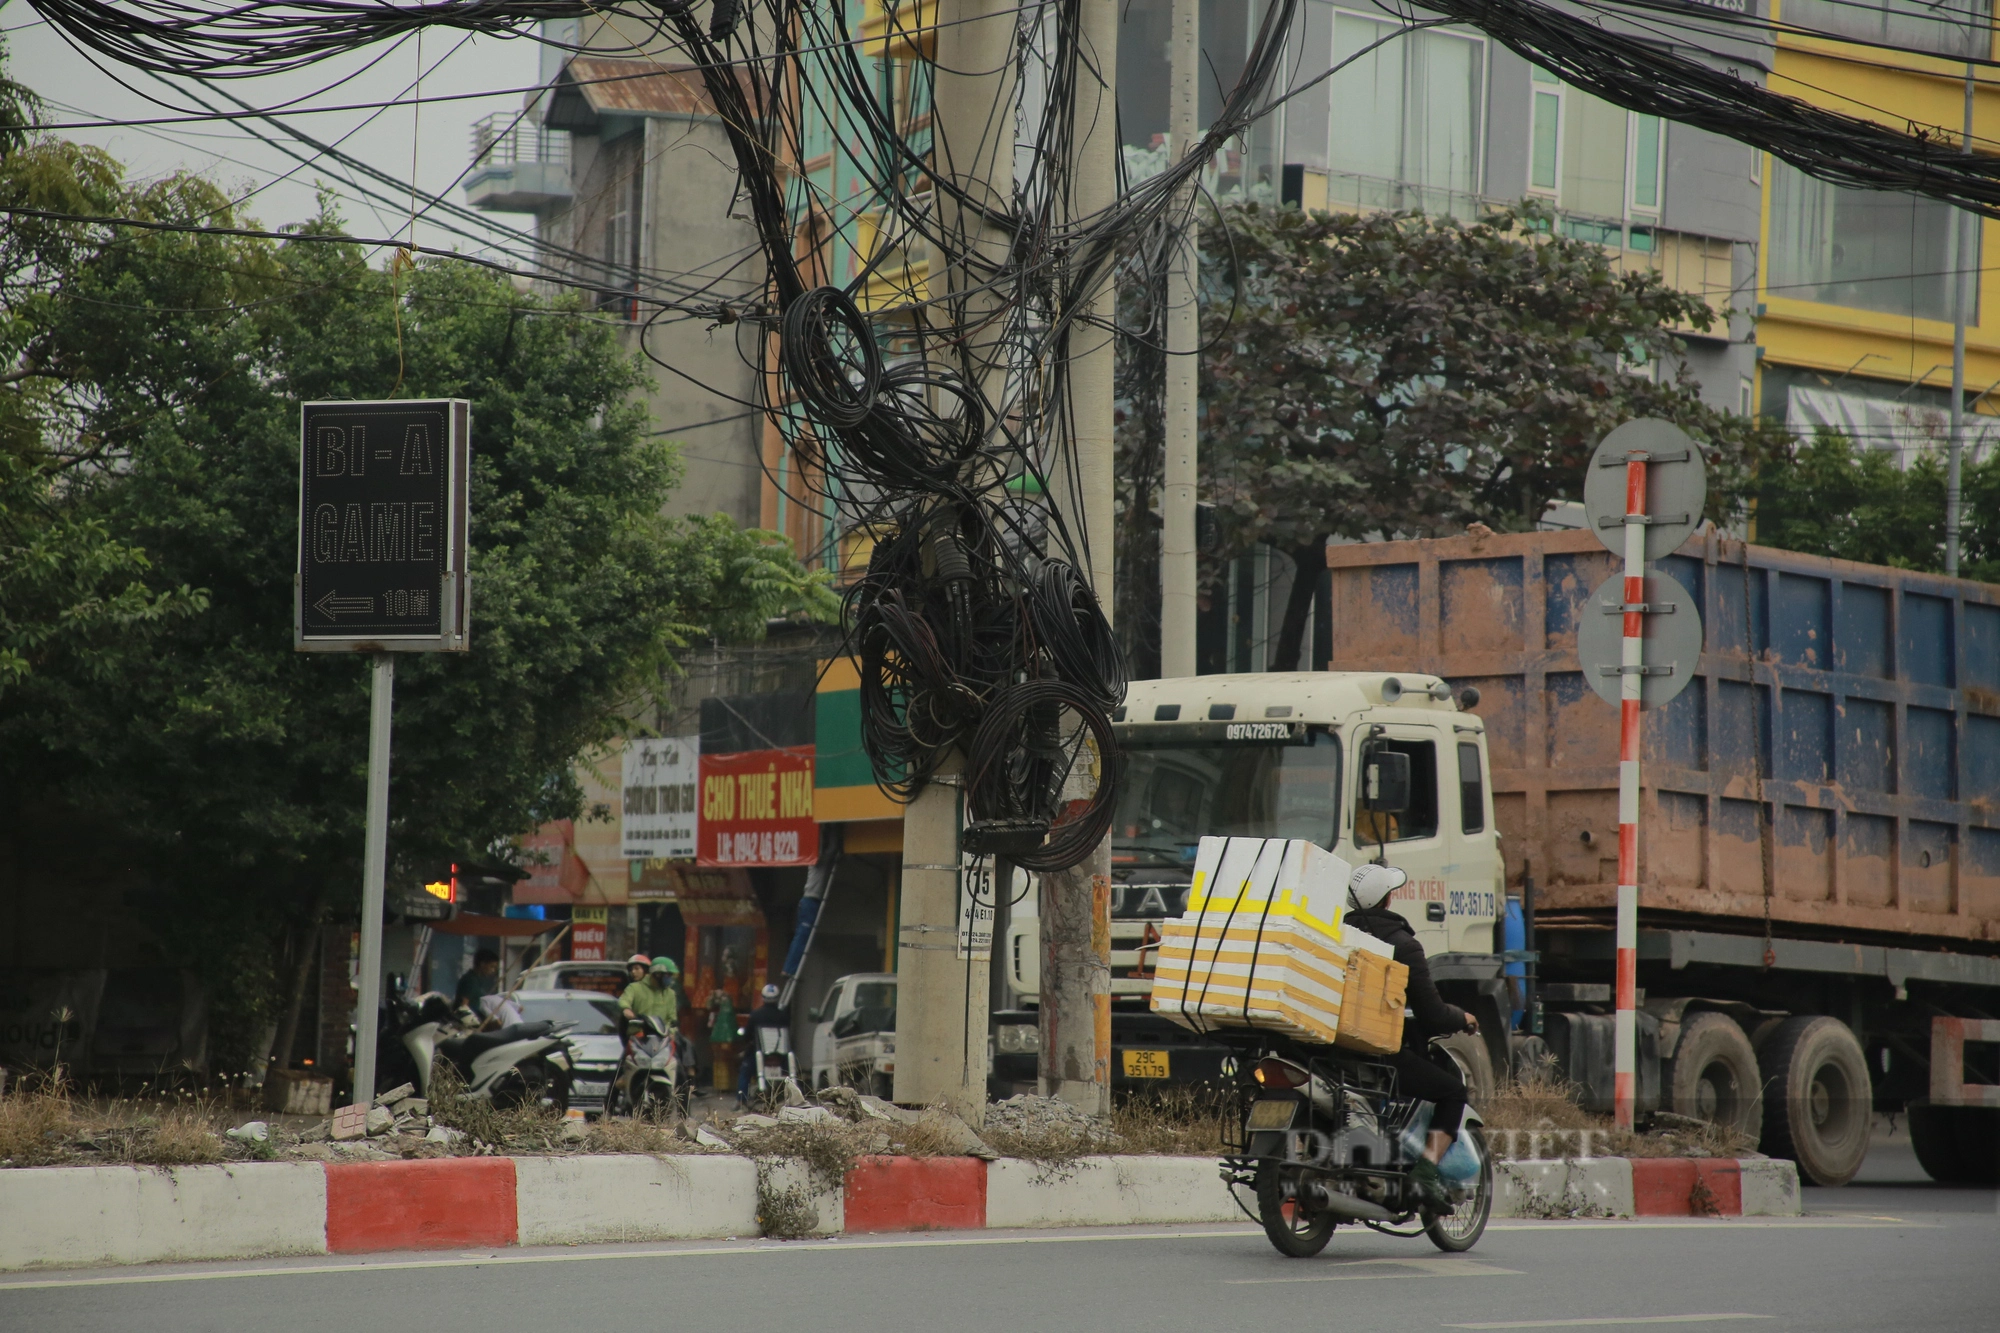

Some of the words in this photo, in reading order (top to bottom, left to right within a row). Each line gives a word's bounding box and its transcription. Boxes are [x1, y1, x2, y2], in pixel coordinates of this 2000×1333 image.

[313, 502, 434, 563] GAME
[703, 774, 736, 821] CHO
[738, 762, 777, 820] THUÊ
[780, 759, 814, 818] NHÀ
[1419, 876, 1446, 901] KIÊN
[1449, 890, 1495, 917] 29C-351.79
[1127, 1065, 1165, 1077] 351.79
[1135, 1052, 1156, 1064] 29C
